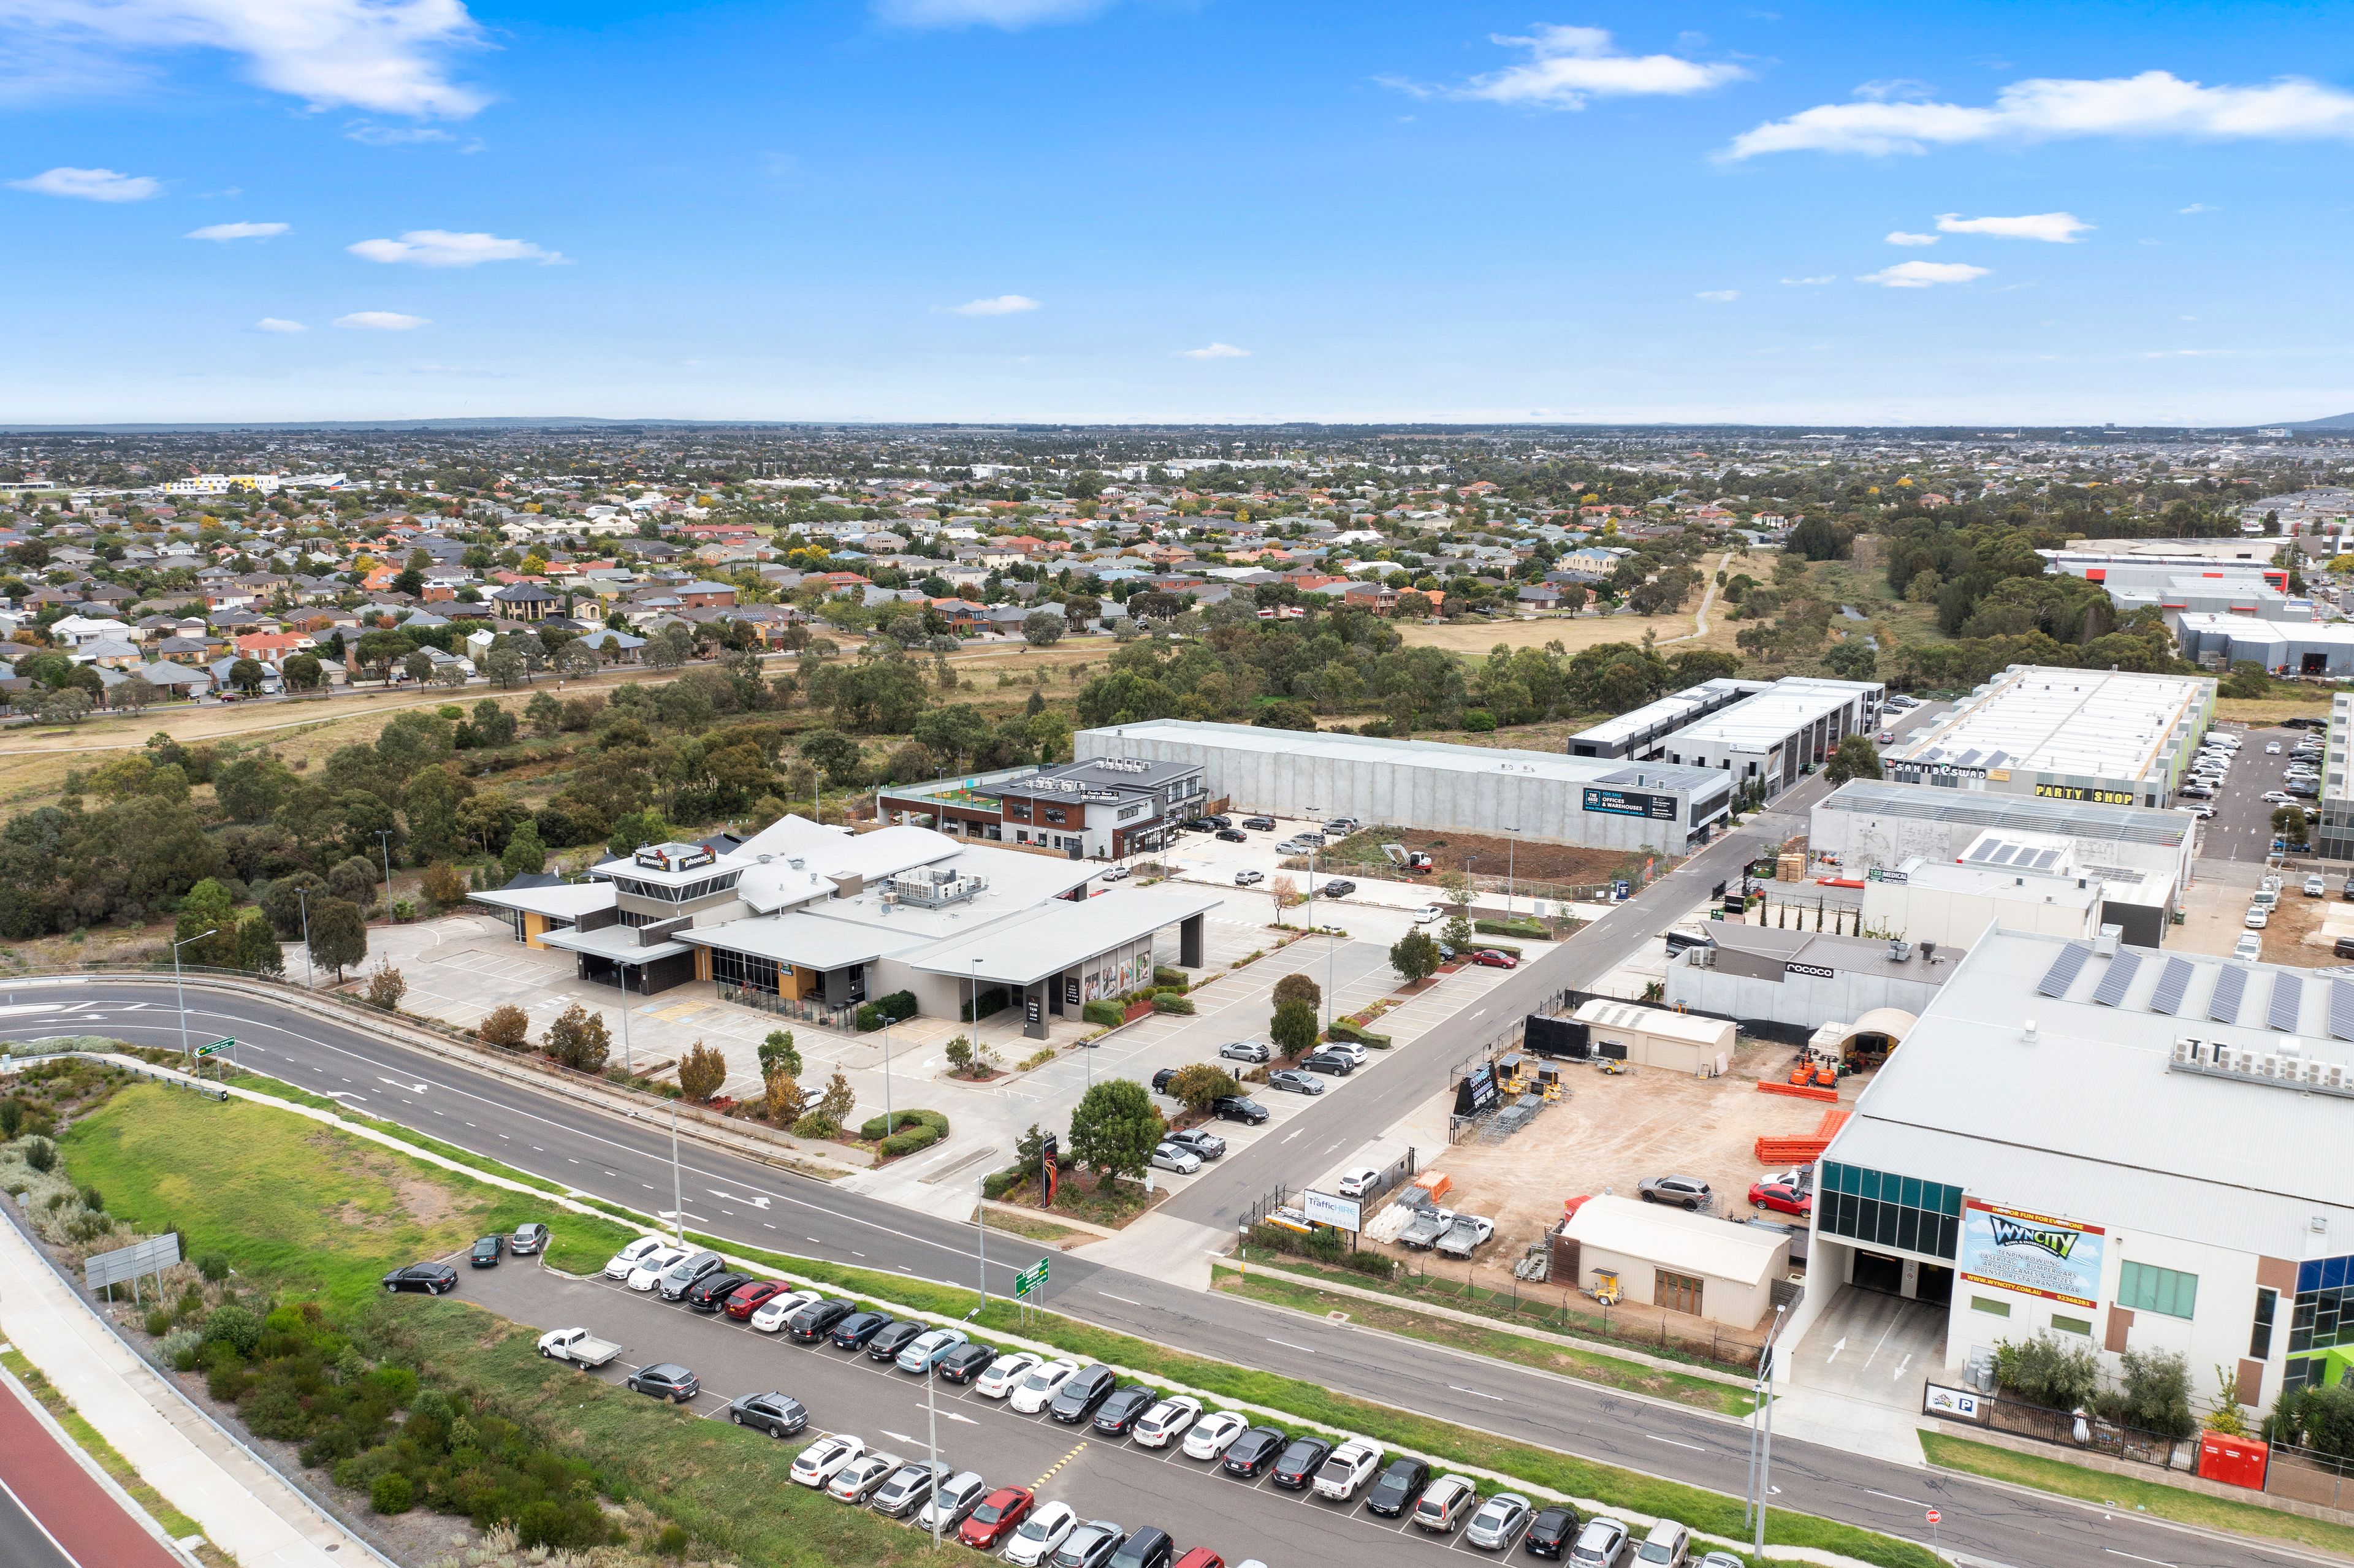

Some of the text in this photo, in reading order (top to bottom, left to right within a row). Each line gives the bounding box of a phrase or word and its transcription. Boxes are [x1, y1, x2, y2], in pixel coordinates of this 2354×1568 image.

[2036, 786, 2132, 805] PARTY SHOP
[640, 857, 665, 867] phoenix
[685, 854, 711, 867] phoenix
[1883, 871, 1907, 880] MEDICAL
[1787, 964, 1832, 976] rococo
[1474, 1094, 1487, 1108] HIRE
[1486, 1087, 1495, 1100] ME
[1325, 1217, 1356, 1228] MESSAGE
[2021, 1212, 2034, 1220] FUN
[1992, 1217, 2078, 1257] WYNCITY
[2024, 1240, 2059, 1255] ENTERTAINMENT
[1980, 1252, 2001, 1262] LASER
[2026, 1263, 2056, 1275] BUMPER
[2058, 1269, 2077, 1278] CARS
[1998, 1249, 2061, 1268] TENPIN BOWLING
[1975, 1266, 2007, 1278] LICENSED
[2009, 1273, 2055, 1288] RESTAURANT
[2065, 1285, 2080, 1294] BAR
[1983, 1260, 2011, 1271] ARCADE
[2013, 1267, 2038, 1277] GAMES
[2048, 1275, 2073, 1285] PRIZES
[1967, 1274, 2041, 1295] WWW.WYNCITY.COM.AU
[1961, 1399, 1971, 1410] P
